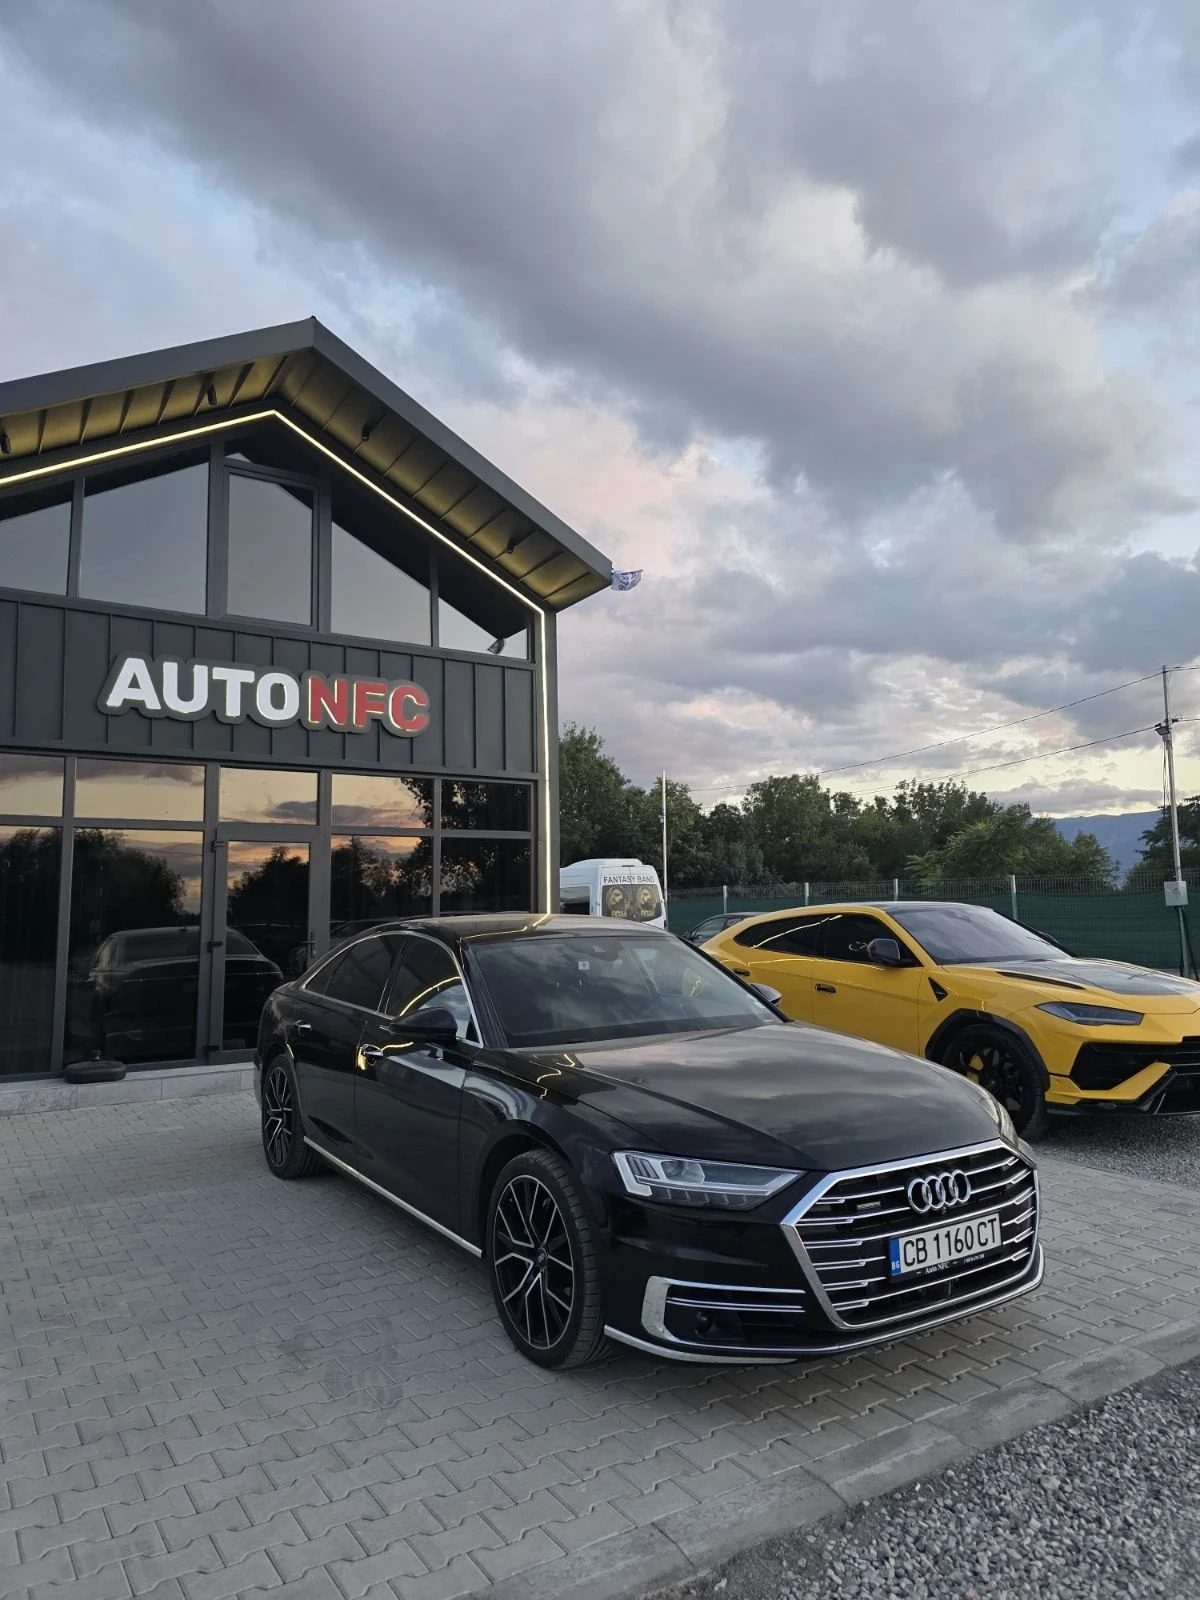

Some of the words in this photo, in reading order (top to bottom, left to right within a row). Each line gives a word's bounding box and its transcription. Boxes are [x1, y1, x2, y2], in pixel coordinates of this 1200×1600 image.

[637, 875, 654, 883] BAND
[891, 1261, 900, 1271] BG
[924, 1265, 938, 1275] Auto
[938, 1262, 950, 1272] NFC
